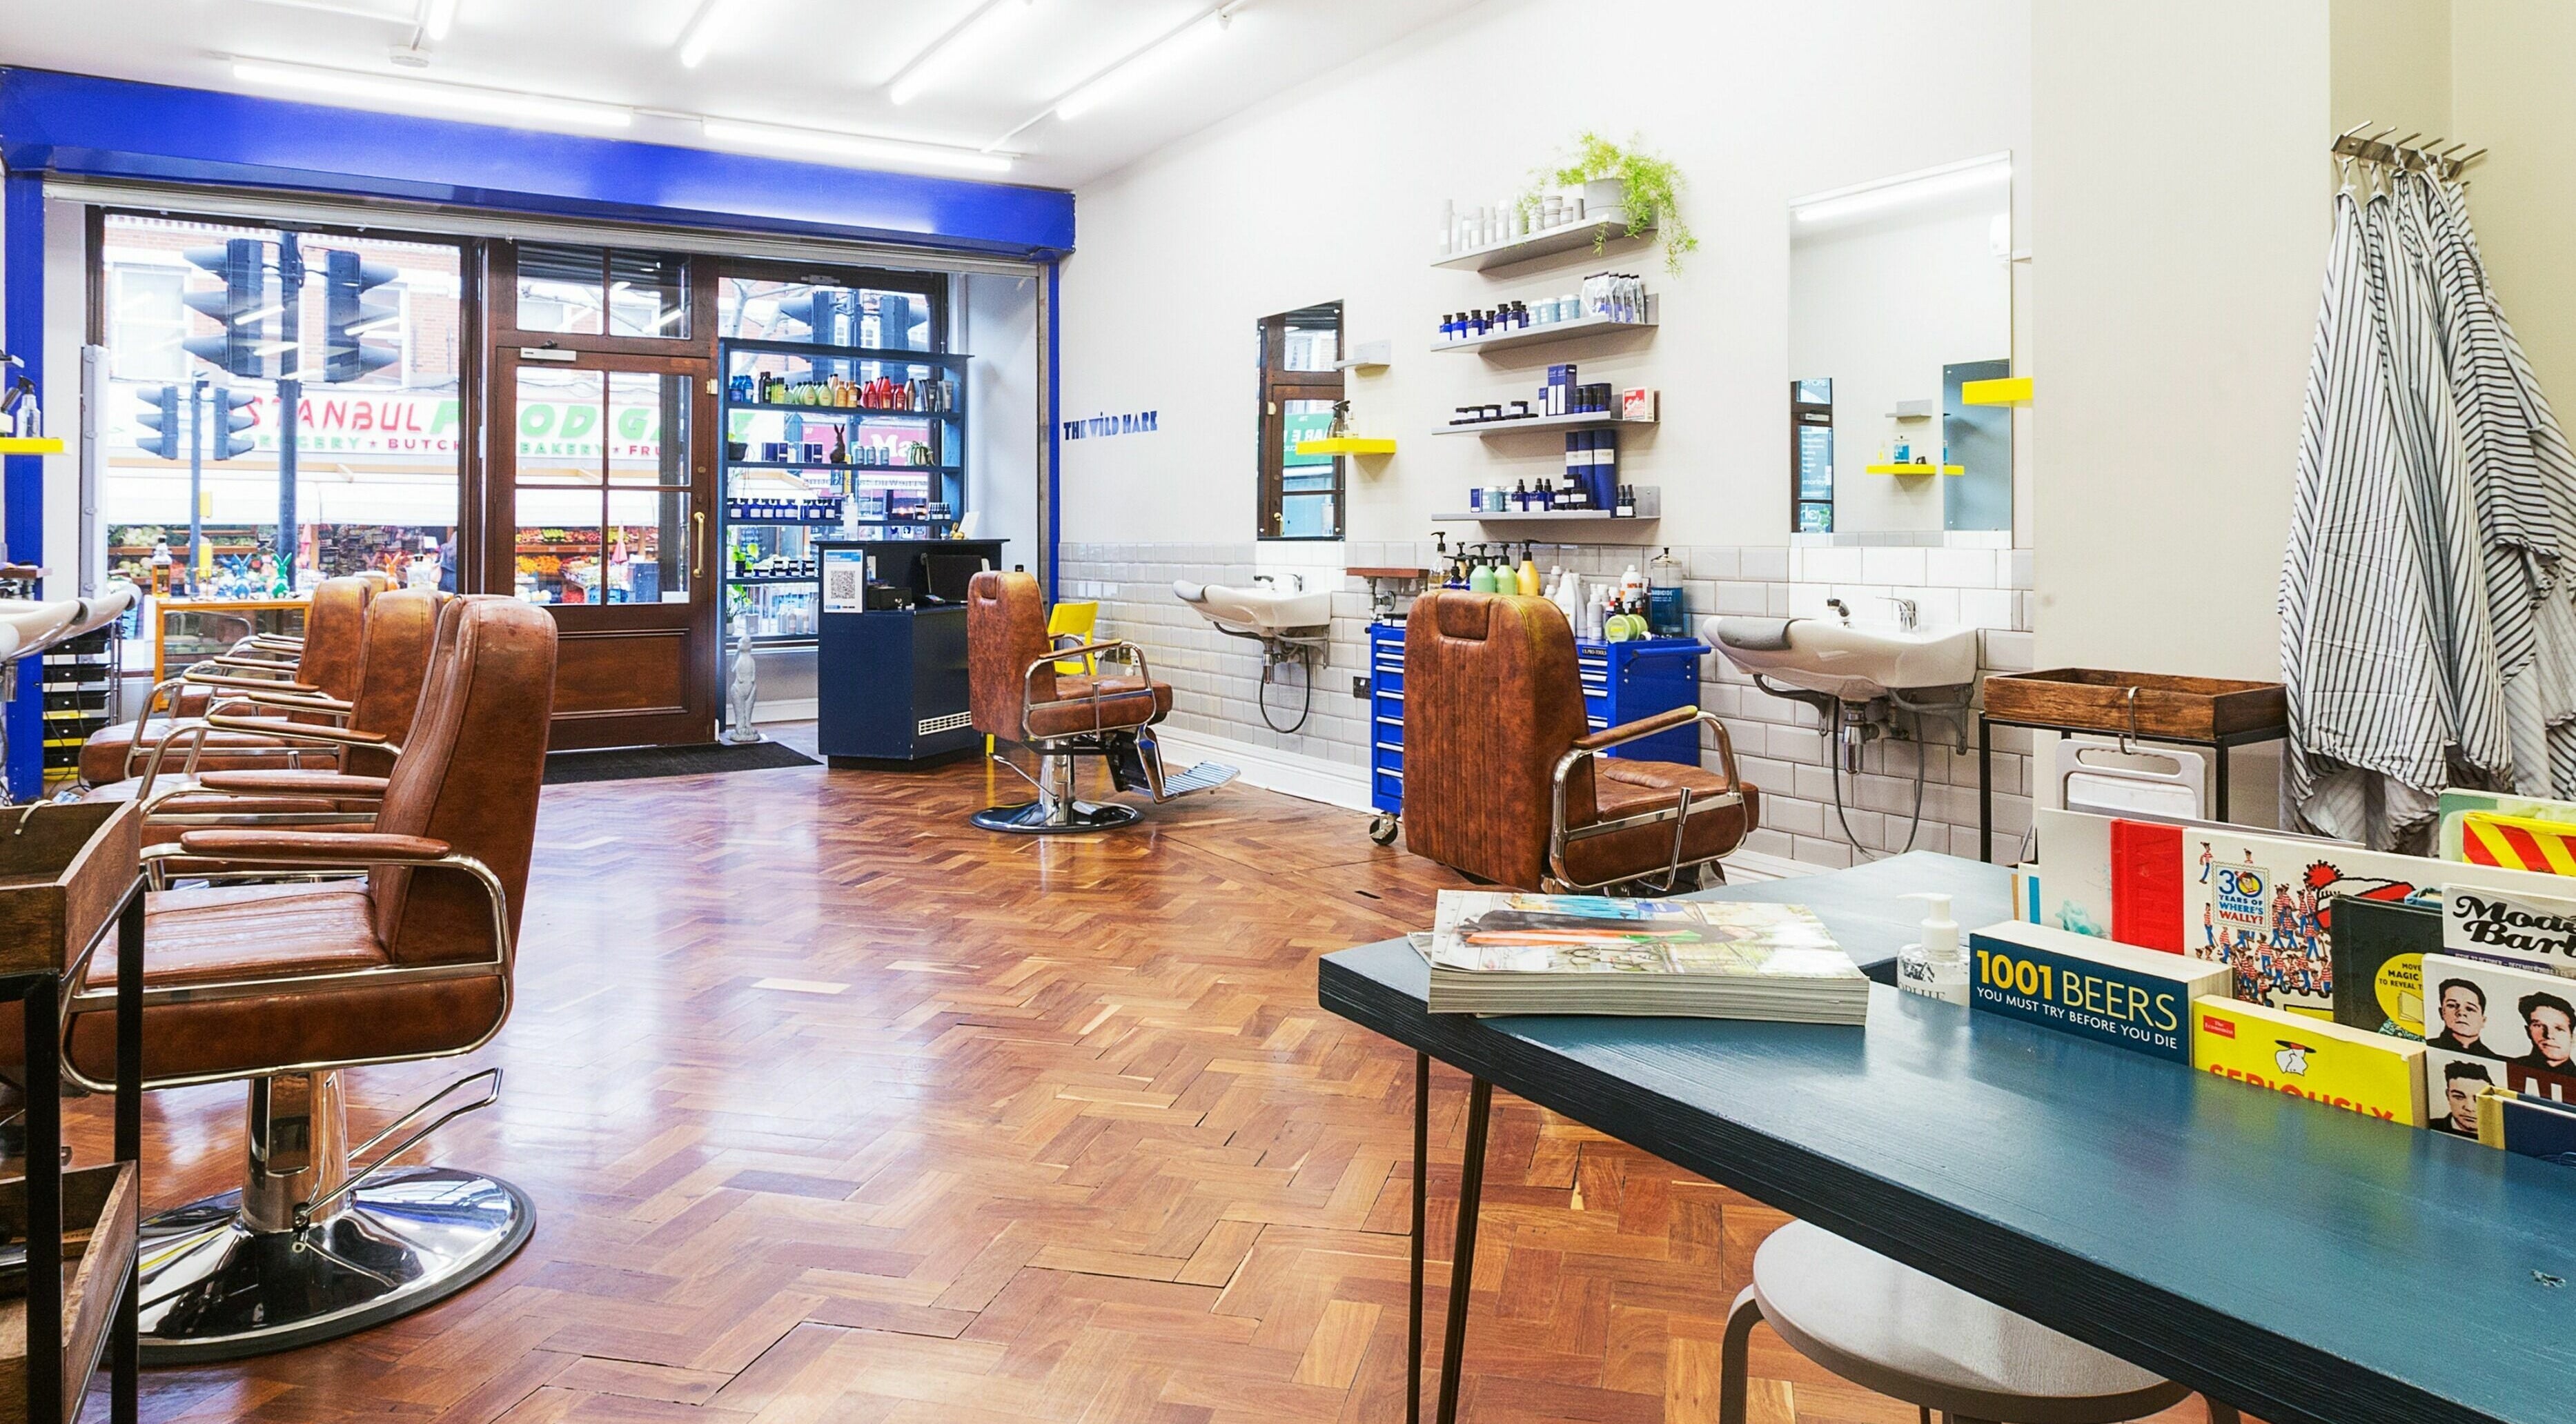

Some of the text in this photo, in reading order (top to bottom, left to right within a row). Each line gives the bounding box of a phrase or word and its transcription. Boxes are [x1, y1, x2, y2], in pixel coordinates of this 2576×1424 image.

[230, 397, 422, 431] SANBUL
[1063, 420, 1086, 440] THE
[1123, 411, 1157, 434] HARE
[2219, 870, 2263, 898] 30
[2219, 894, 2248, 904] YEARS
[2219, 902, 2263, 915] WHERE'S
[2219, 910, 2263, 924] WALLY?
[2388, 969, 2419, 980] MAGIC
[2402, 963, 2421, 972] MOVE
[1976, 950, 2178, 1031] 1001 BEERS
[2390, 980, 2416, 989] REVEAL
[1976, 987, 2178, 1049] YOU MUST TRY BEFORE YOU DIE
